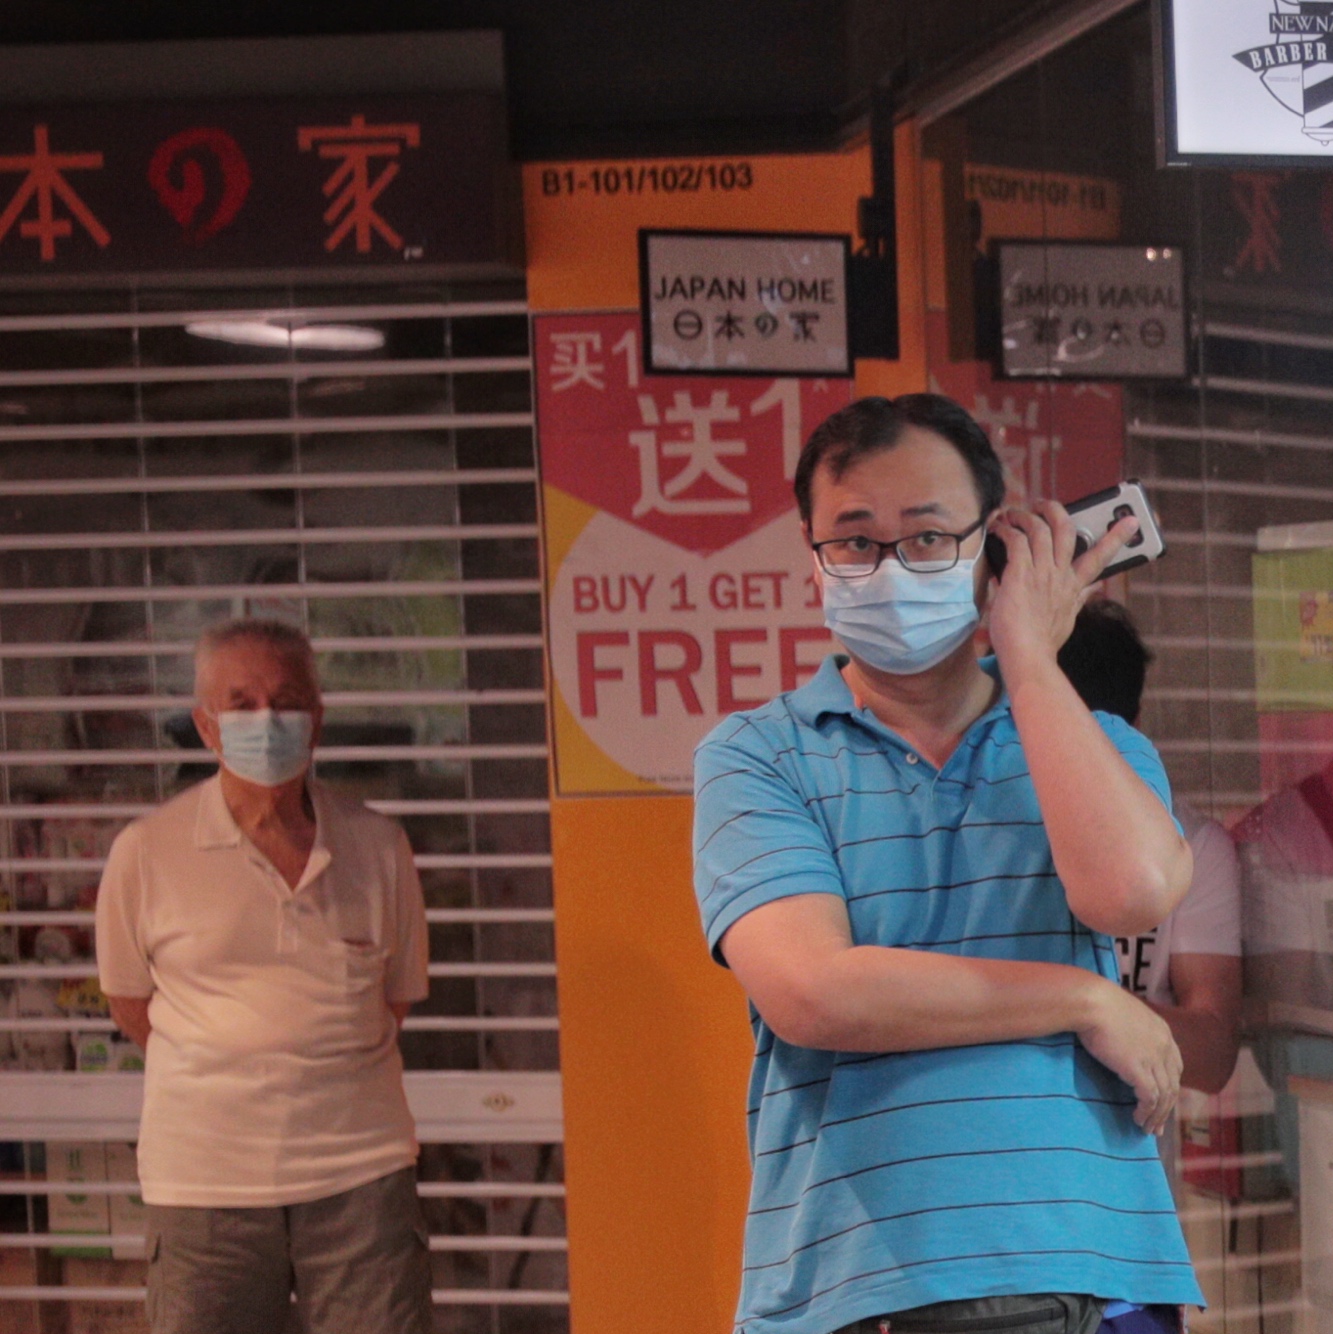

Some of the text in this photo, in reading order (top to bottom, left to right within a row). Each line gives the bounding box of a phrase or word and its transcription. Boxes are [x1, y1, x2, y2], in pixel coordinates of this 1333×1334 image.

[1271, 14, 1315, 32] NEW
[1249, 42, 1328, 69] BARBER
[541, 162, 753, 196] B1-101/102/103
[655, 275, 836, 304] JAPAN HOME
[572, 573, 655, 614] BUY
[669, 571, 697, 612] 1
[707, 571, 789, 611] GET
